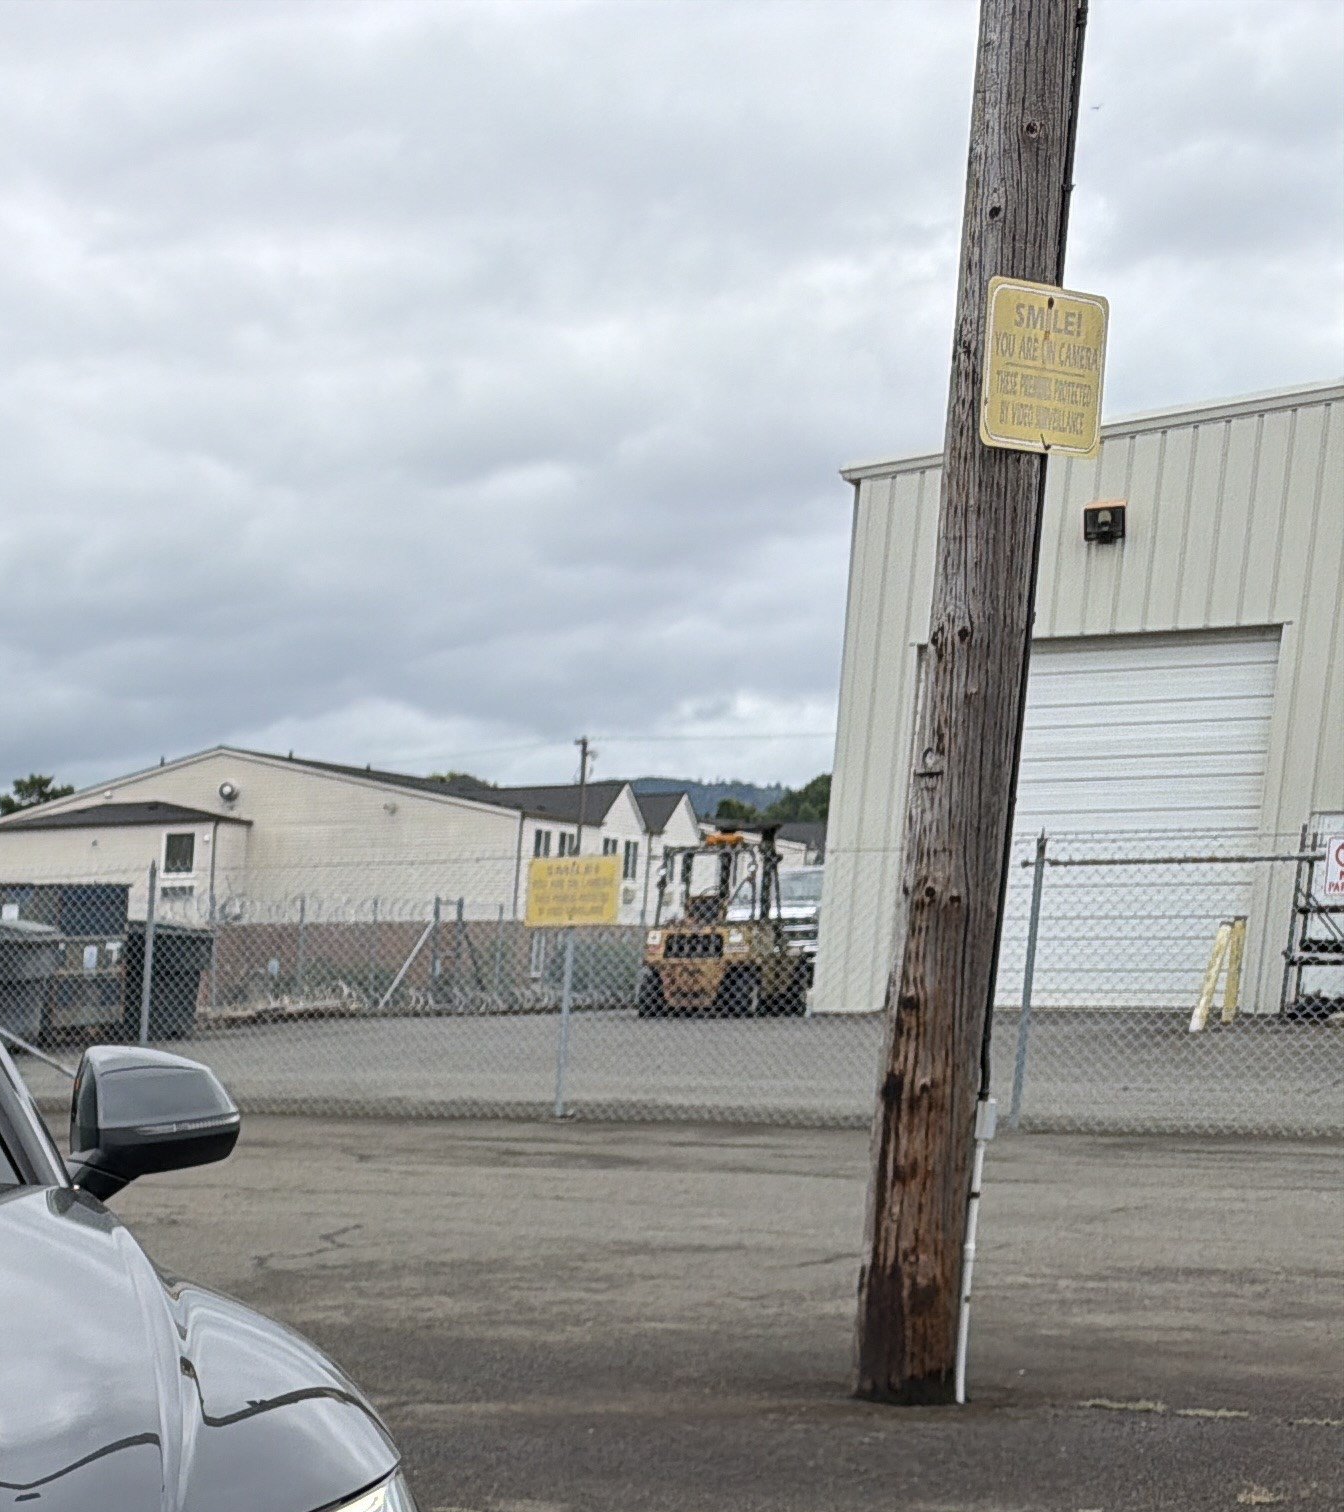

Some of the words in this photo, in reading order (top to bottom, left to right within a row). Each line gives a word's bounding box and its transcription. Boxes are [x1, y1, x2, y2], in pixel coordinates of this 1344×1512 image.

[1014, 303, 1083, 337] SMILE!
[995, 331, 1016, 358] YOU
[1018, 335, 1039, 361] ARE
